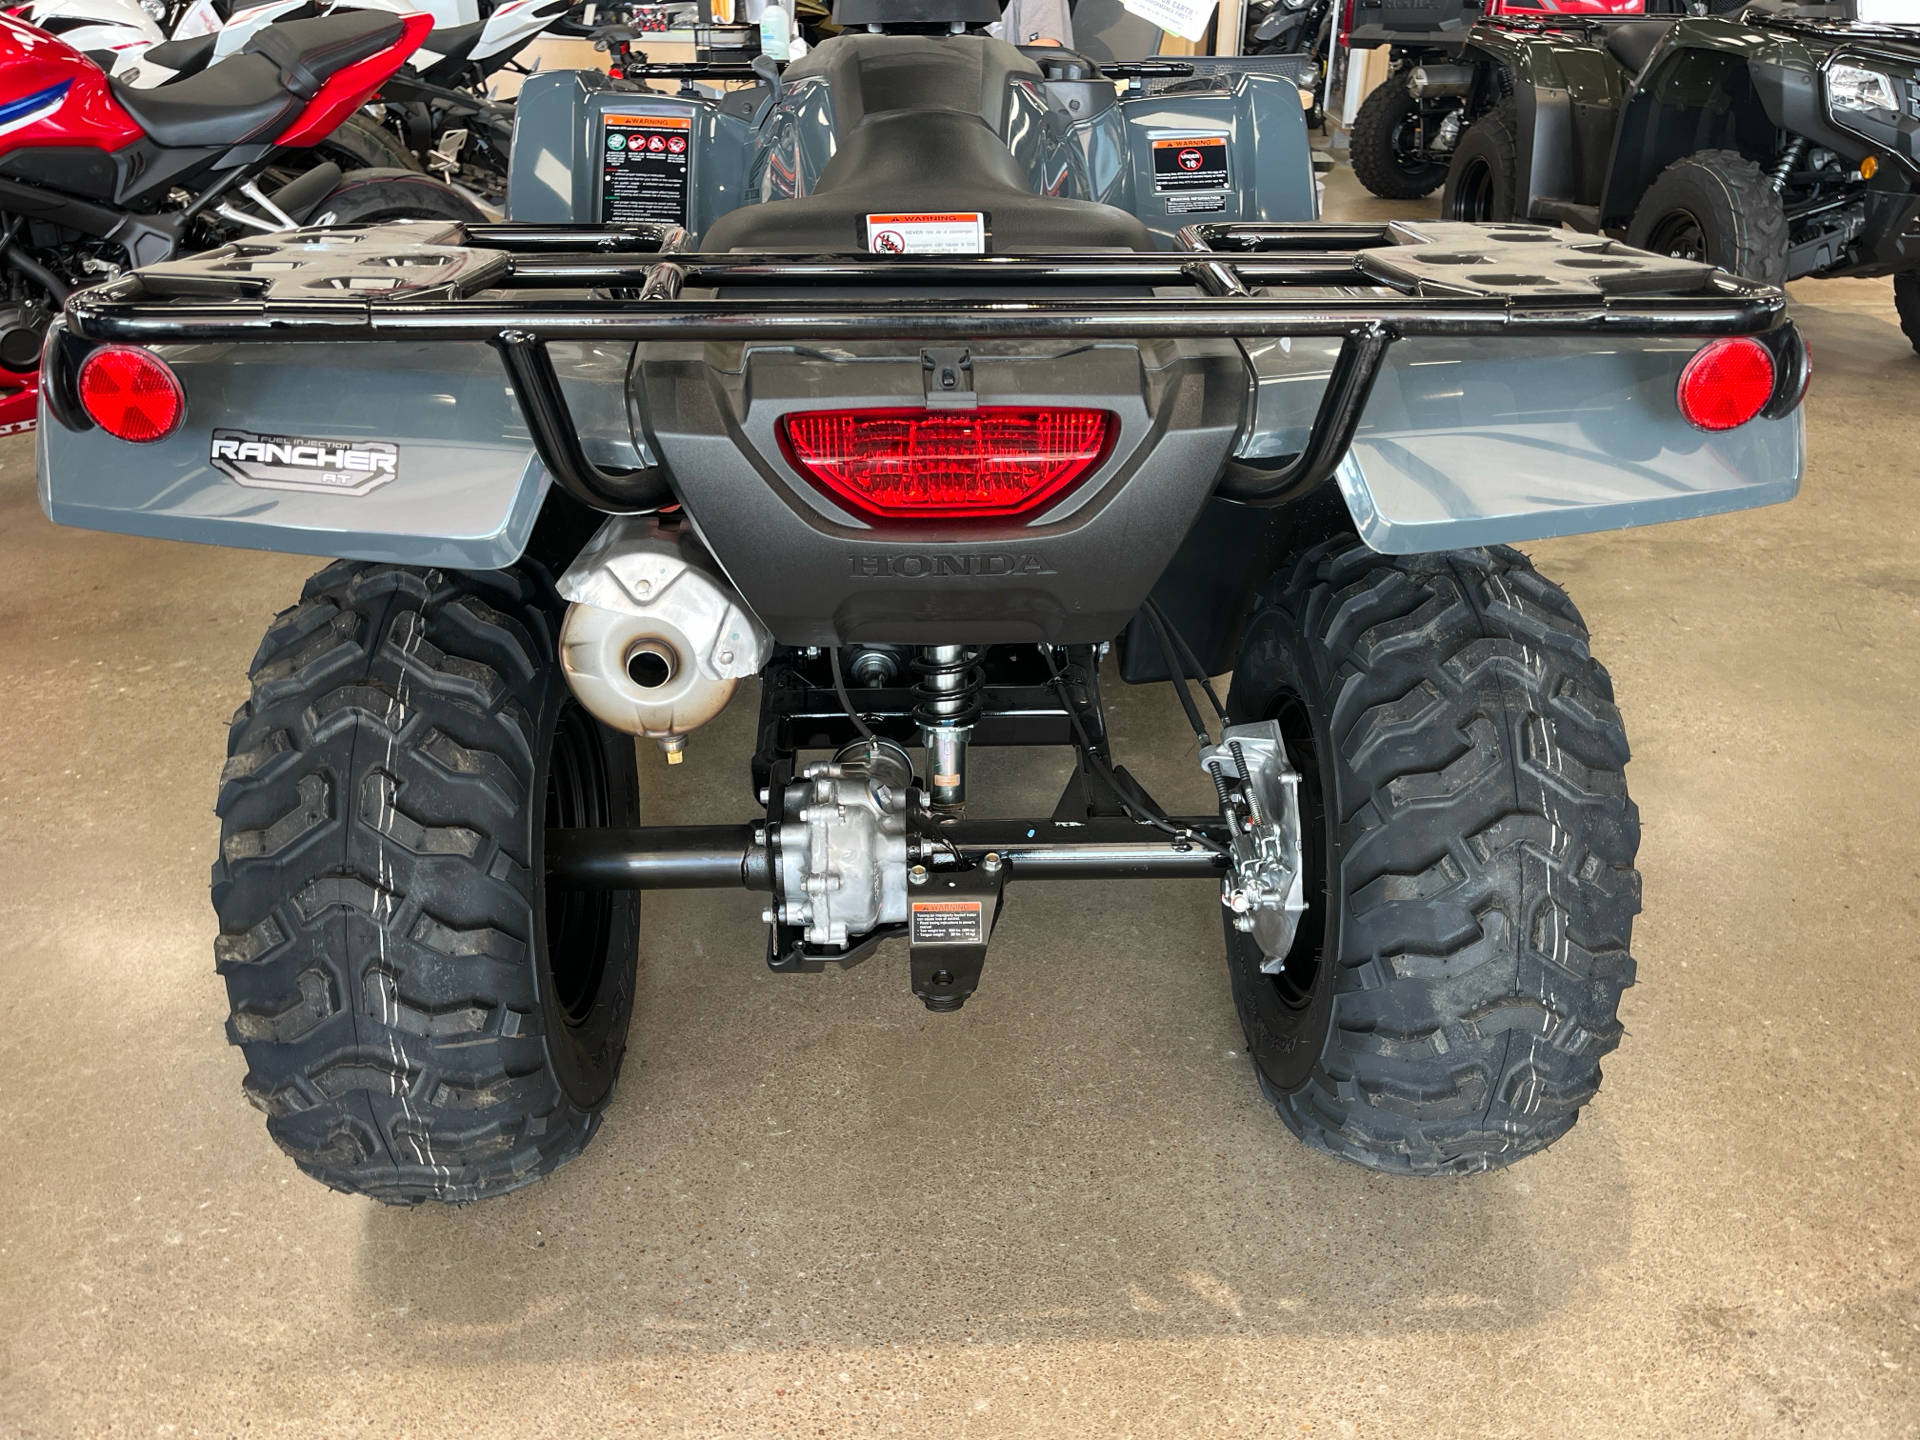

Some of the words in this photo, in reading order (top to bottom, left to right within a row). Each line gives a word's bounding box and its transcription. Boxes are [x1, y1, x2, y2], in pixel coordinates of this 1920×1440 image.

[1172, 1, 1194, 16] EARTH
[632, 118, 668, 126] WARNING
[260, 436, 290, 445] FUEL
[293, 439, 350, 450] INJECTION
[211, 439, 398, 474] RANCHER
[322, 473, 351, 484] AT
[848, 552, 1058, 578] HONDA
